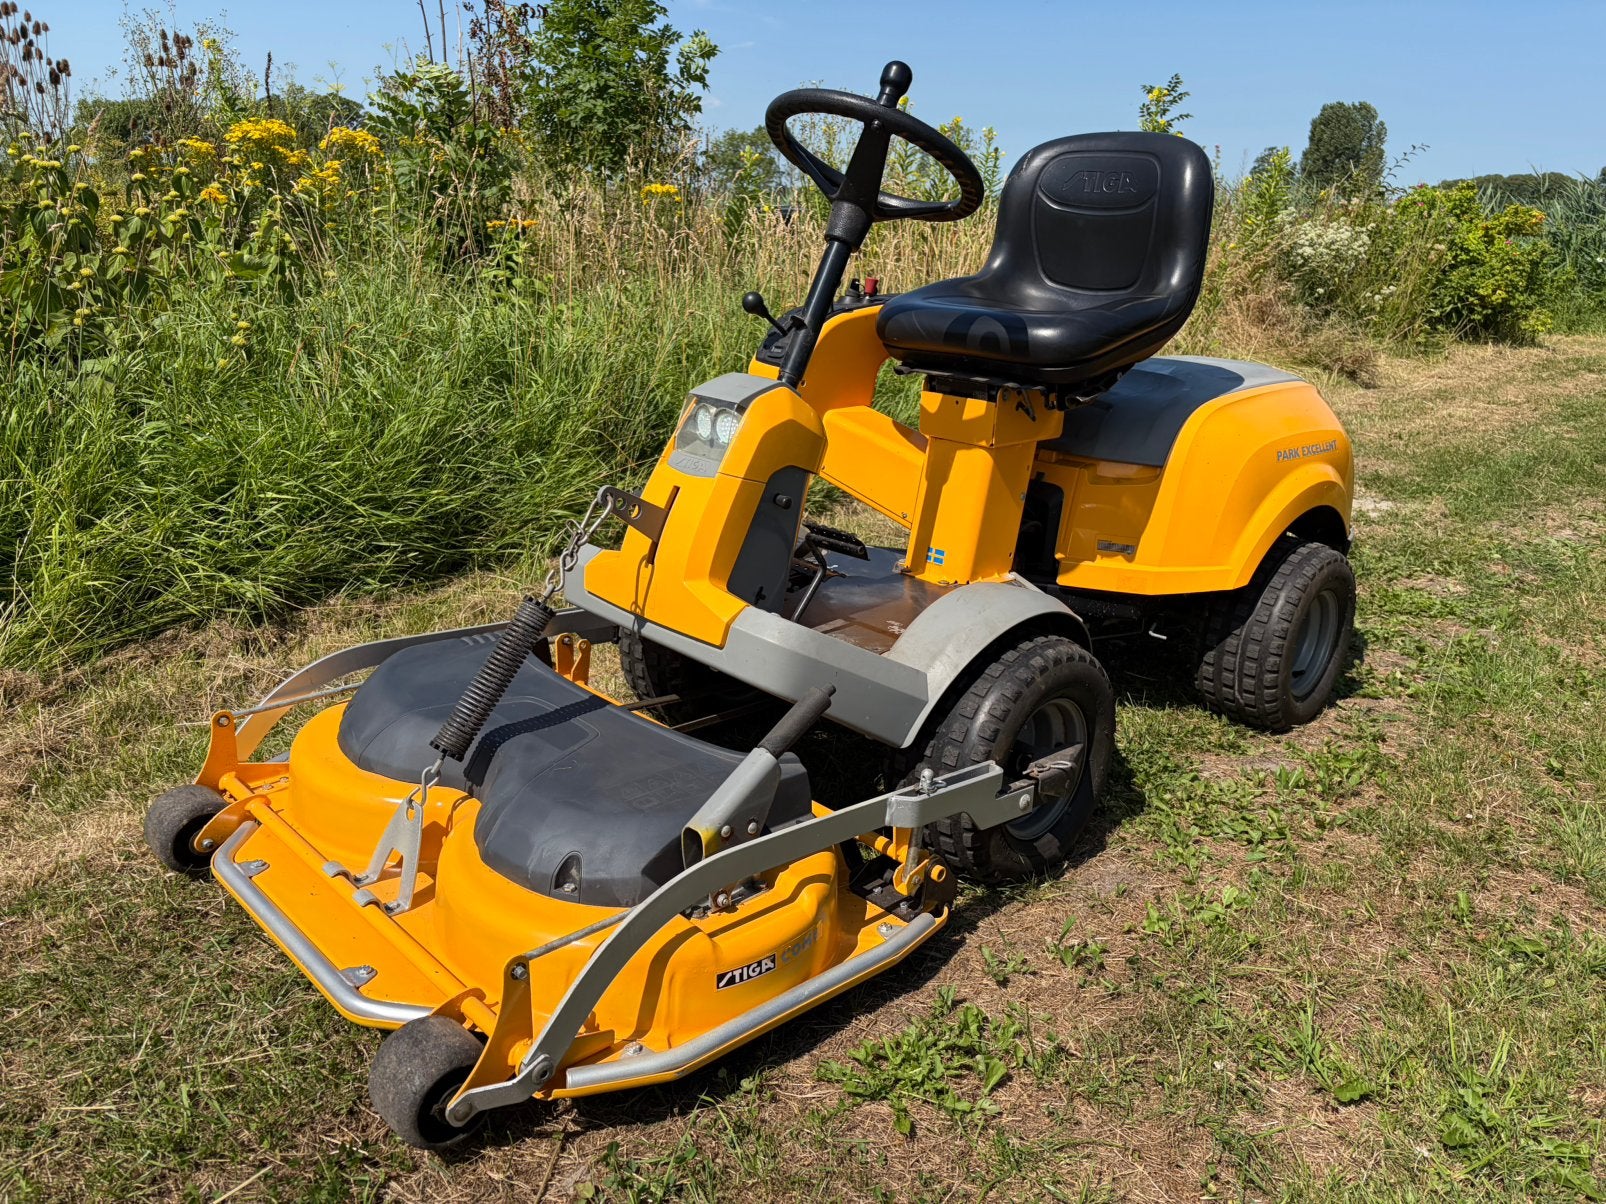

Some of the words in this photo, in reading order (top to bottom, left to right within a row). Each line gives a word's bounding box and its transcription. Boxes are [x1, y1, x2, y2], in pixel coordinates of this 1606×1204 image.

[1062, 170, 1136, 193] STIGA
[1277, 448, 1300, 461] PARK
[1301, 440, 1337, 457] EXCELLENT
[718, 956, 775, 988] STIGA
